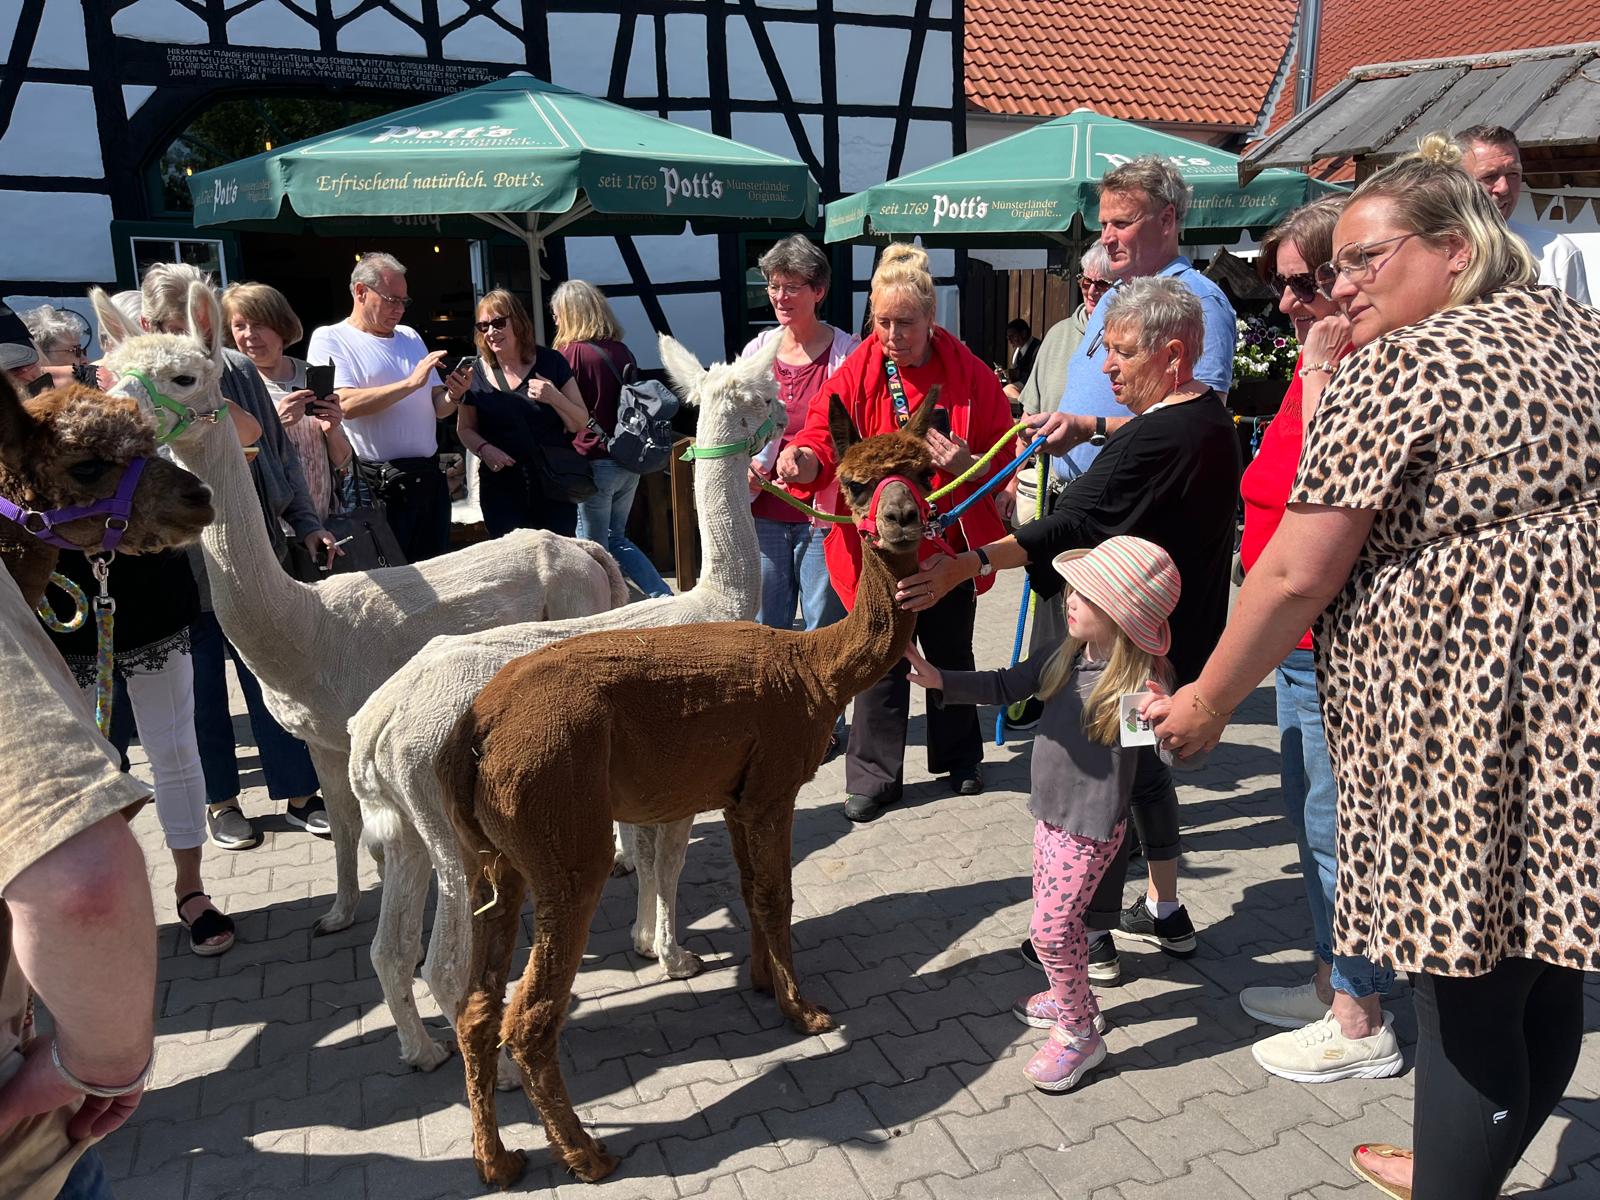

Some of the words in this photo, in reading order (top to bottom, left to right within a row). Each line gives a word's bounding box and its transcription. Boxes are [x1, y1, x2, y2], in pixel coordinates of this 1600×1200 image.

[1095, 153, 1210, 168] Pt's
[213, 178, 239, 215] Pott's
[316, 172, 412, 197] Erfrischend
[412, 170, 487, 189] natürlich.
[493, 172, 545, 188] Pott's.
[598, 175, 622, 189] seit
[626, 175, 657, 191] 1769
[659, 166, 724, 208] Pott's
[879, 202, 899, 215] seit
[901, 202, 928, 215] 1769
[932, 194, 991, 227] Pott's
[991, 198, 1058, 210] Münsterländer
[1186, 193, 1235, 209] atürlich.
[1239, 193, 1279, 209] Pott's.
[885, 360, 901, 390] LOVE
[893, 392, 910, 422] LOVE
